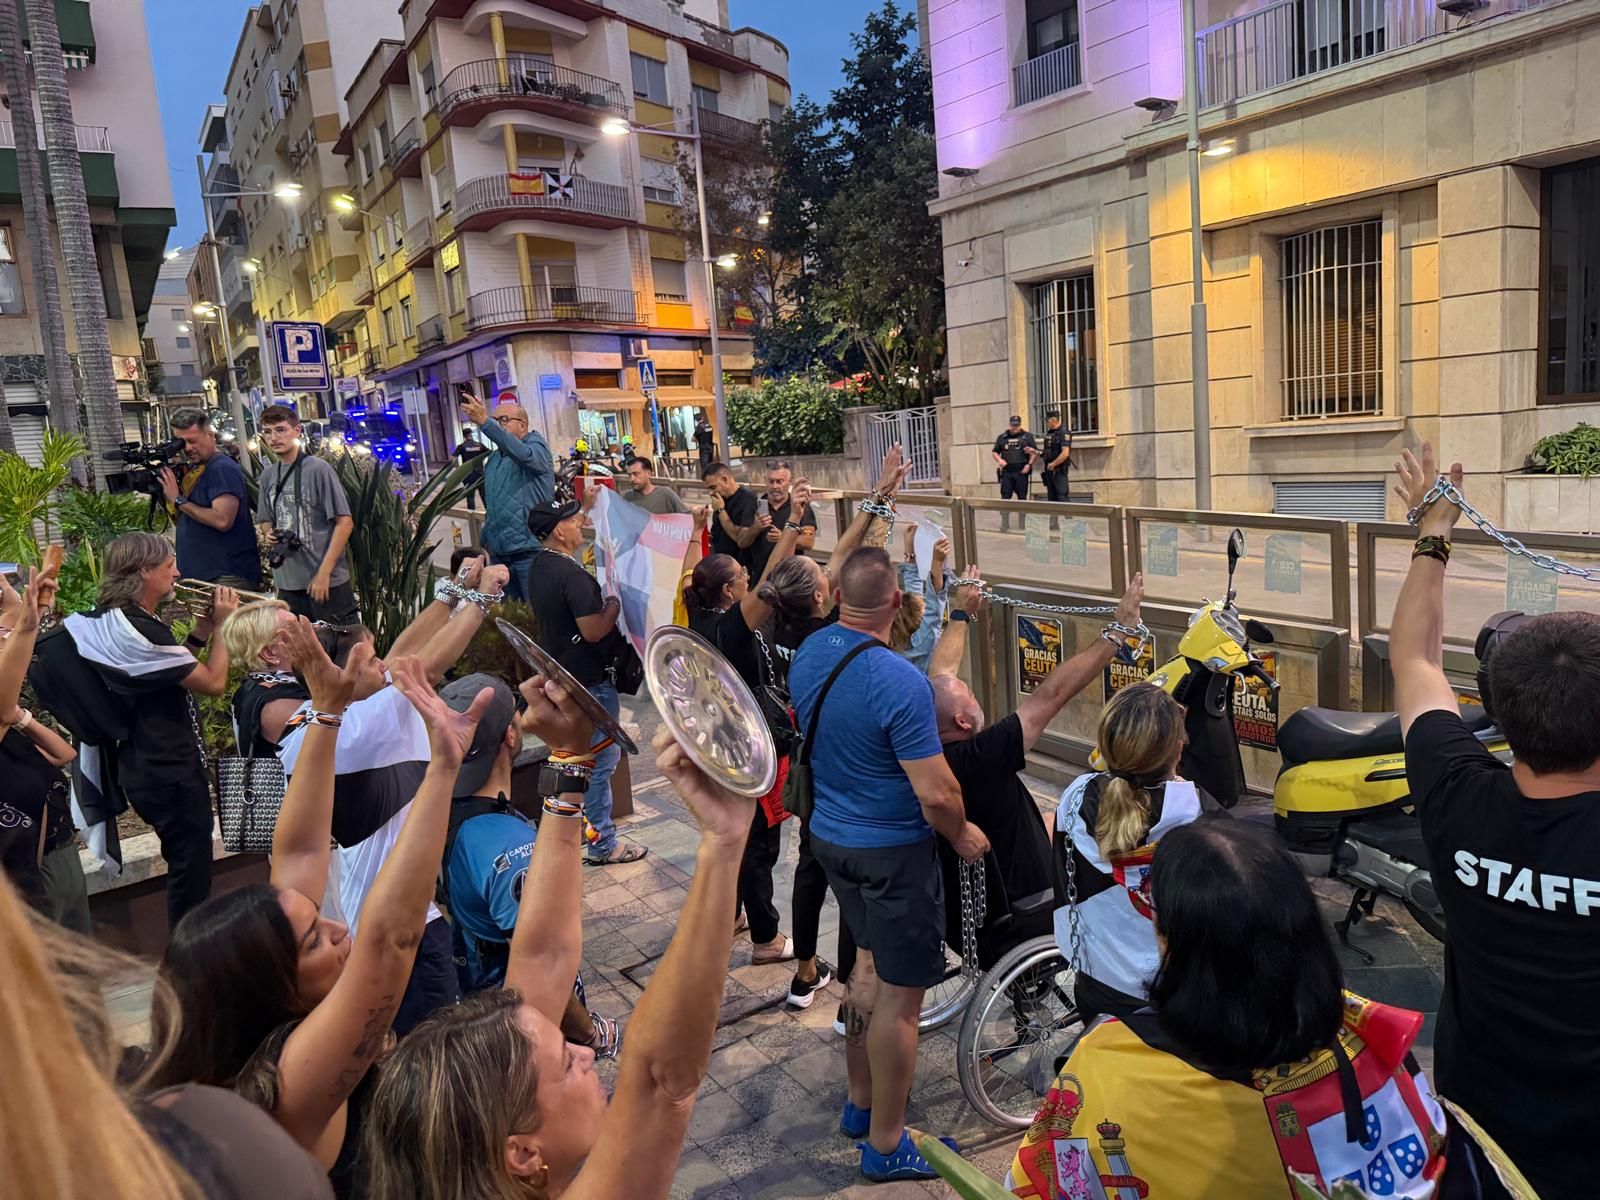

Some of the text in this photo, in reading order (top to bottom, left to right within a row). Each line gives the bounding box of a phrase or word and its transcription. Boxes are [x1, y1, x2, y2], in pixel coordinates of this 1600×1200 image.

[285, 329, 314, 362] P
[1024, 648, 1057, 662] GRACIAS
[1110, 663, 1149, 680] GRACIAS
[1233, 691, 1270, 712] EUTA,
[1254, 710, 1276, 723] SOLOS
[1234, 719, 1276, 737] TAMOS
[1454, 850, 1600, 916] STAFF
